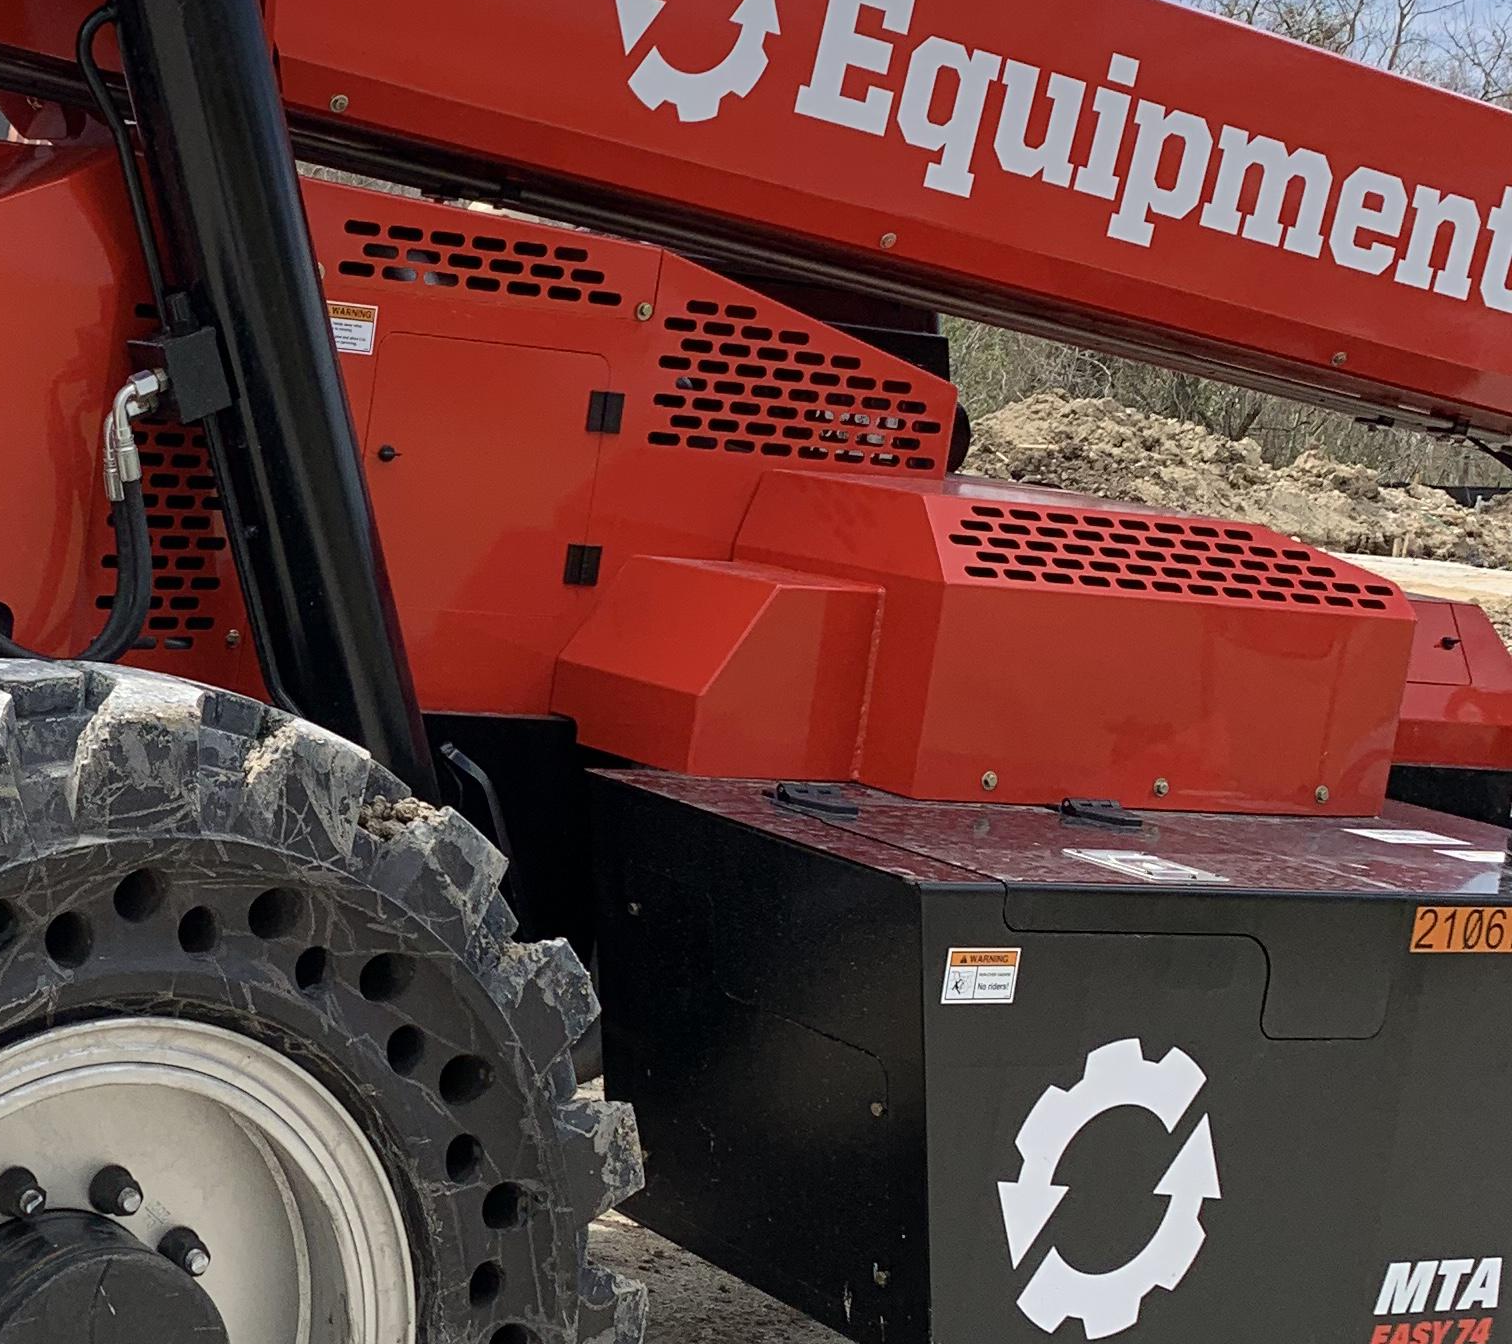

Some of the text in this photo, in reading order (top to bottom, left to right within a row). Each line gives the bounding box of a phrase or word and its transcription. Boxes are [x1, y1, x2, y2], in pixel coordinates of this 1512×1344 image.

[332, 306, 372, 318] WARNING
[1414, 908, 1512, 949] 2106
[970, 955, 1008, 963] WARNING
[978, 982, 1010, 991] No riders!
[1373, 1257, 1503, 1315] MTA
